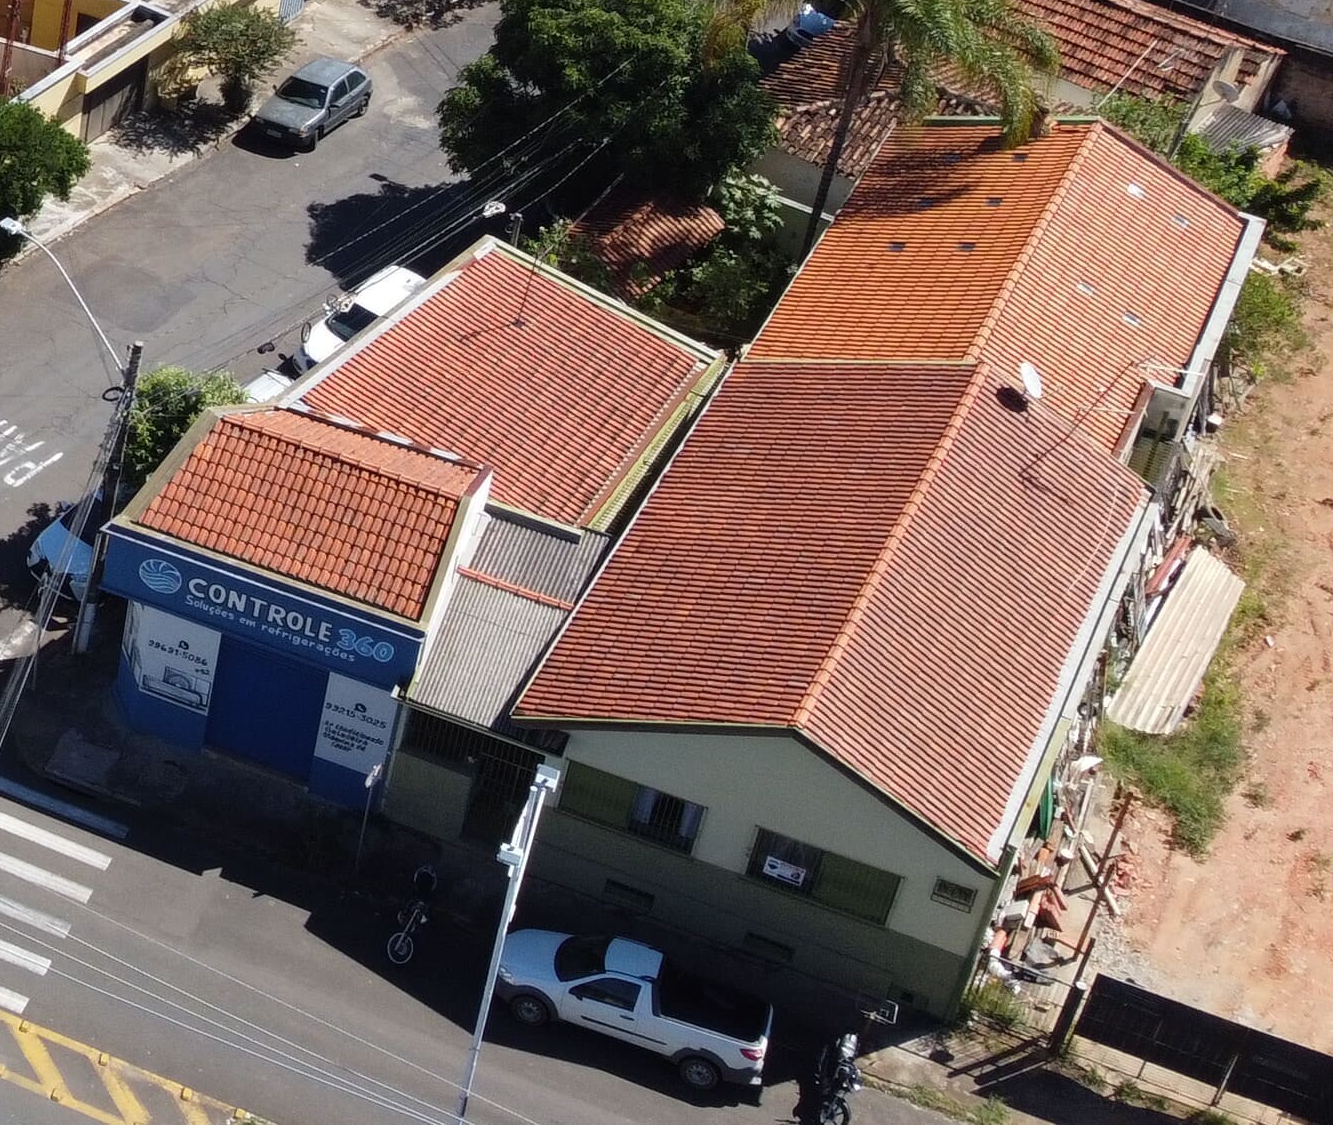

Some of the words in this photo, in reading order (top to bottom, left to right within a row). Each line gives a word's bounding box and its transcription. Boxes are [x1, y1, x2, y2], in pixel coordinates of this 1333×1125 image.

[185, 594, 235, 620] Soluções
[238, 616, 256, 628] em
[261, 624, 355, 662] refrigerações
[187, 577, 334, 643] CONTROLE
[336, 627, 395, 663] 360
